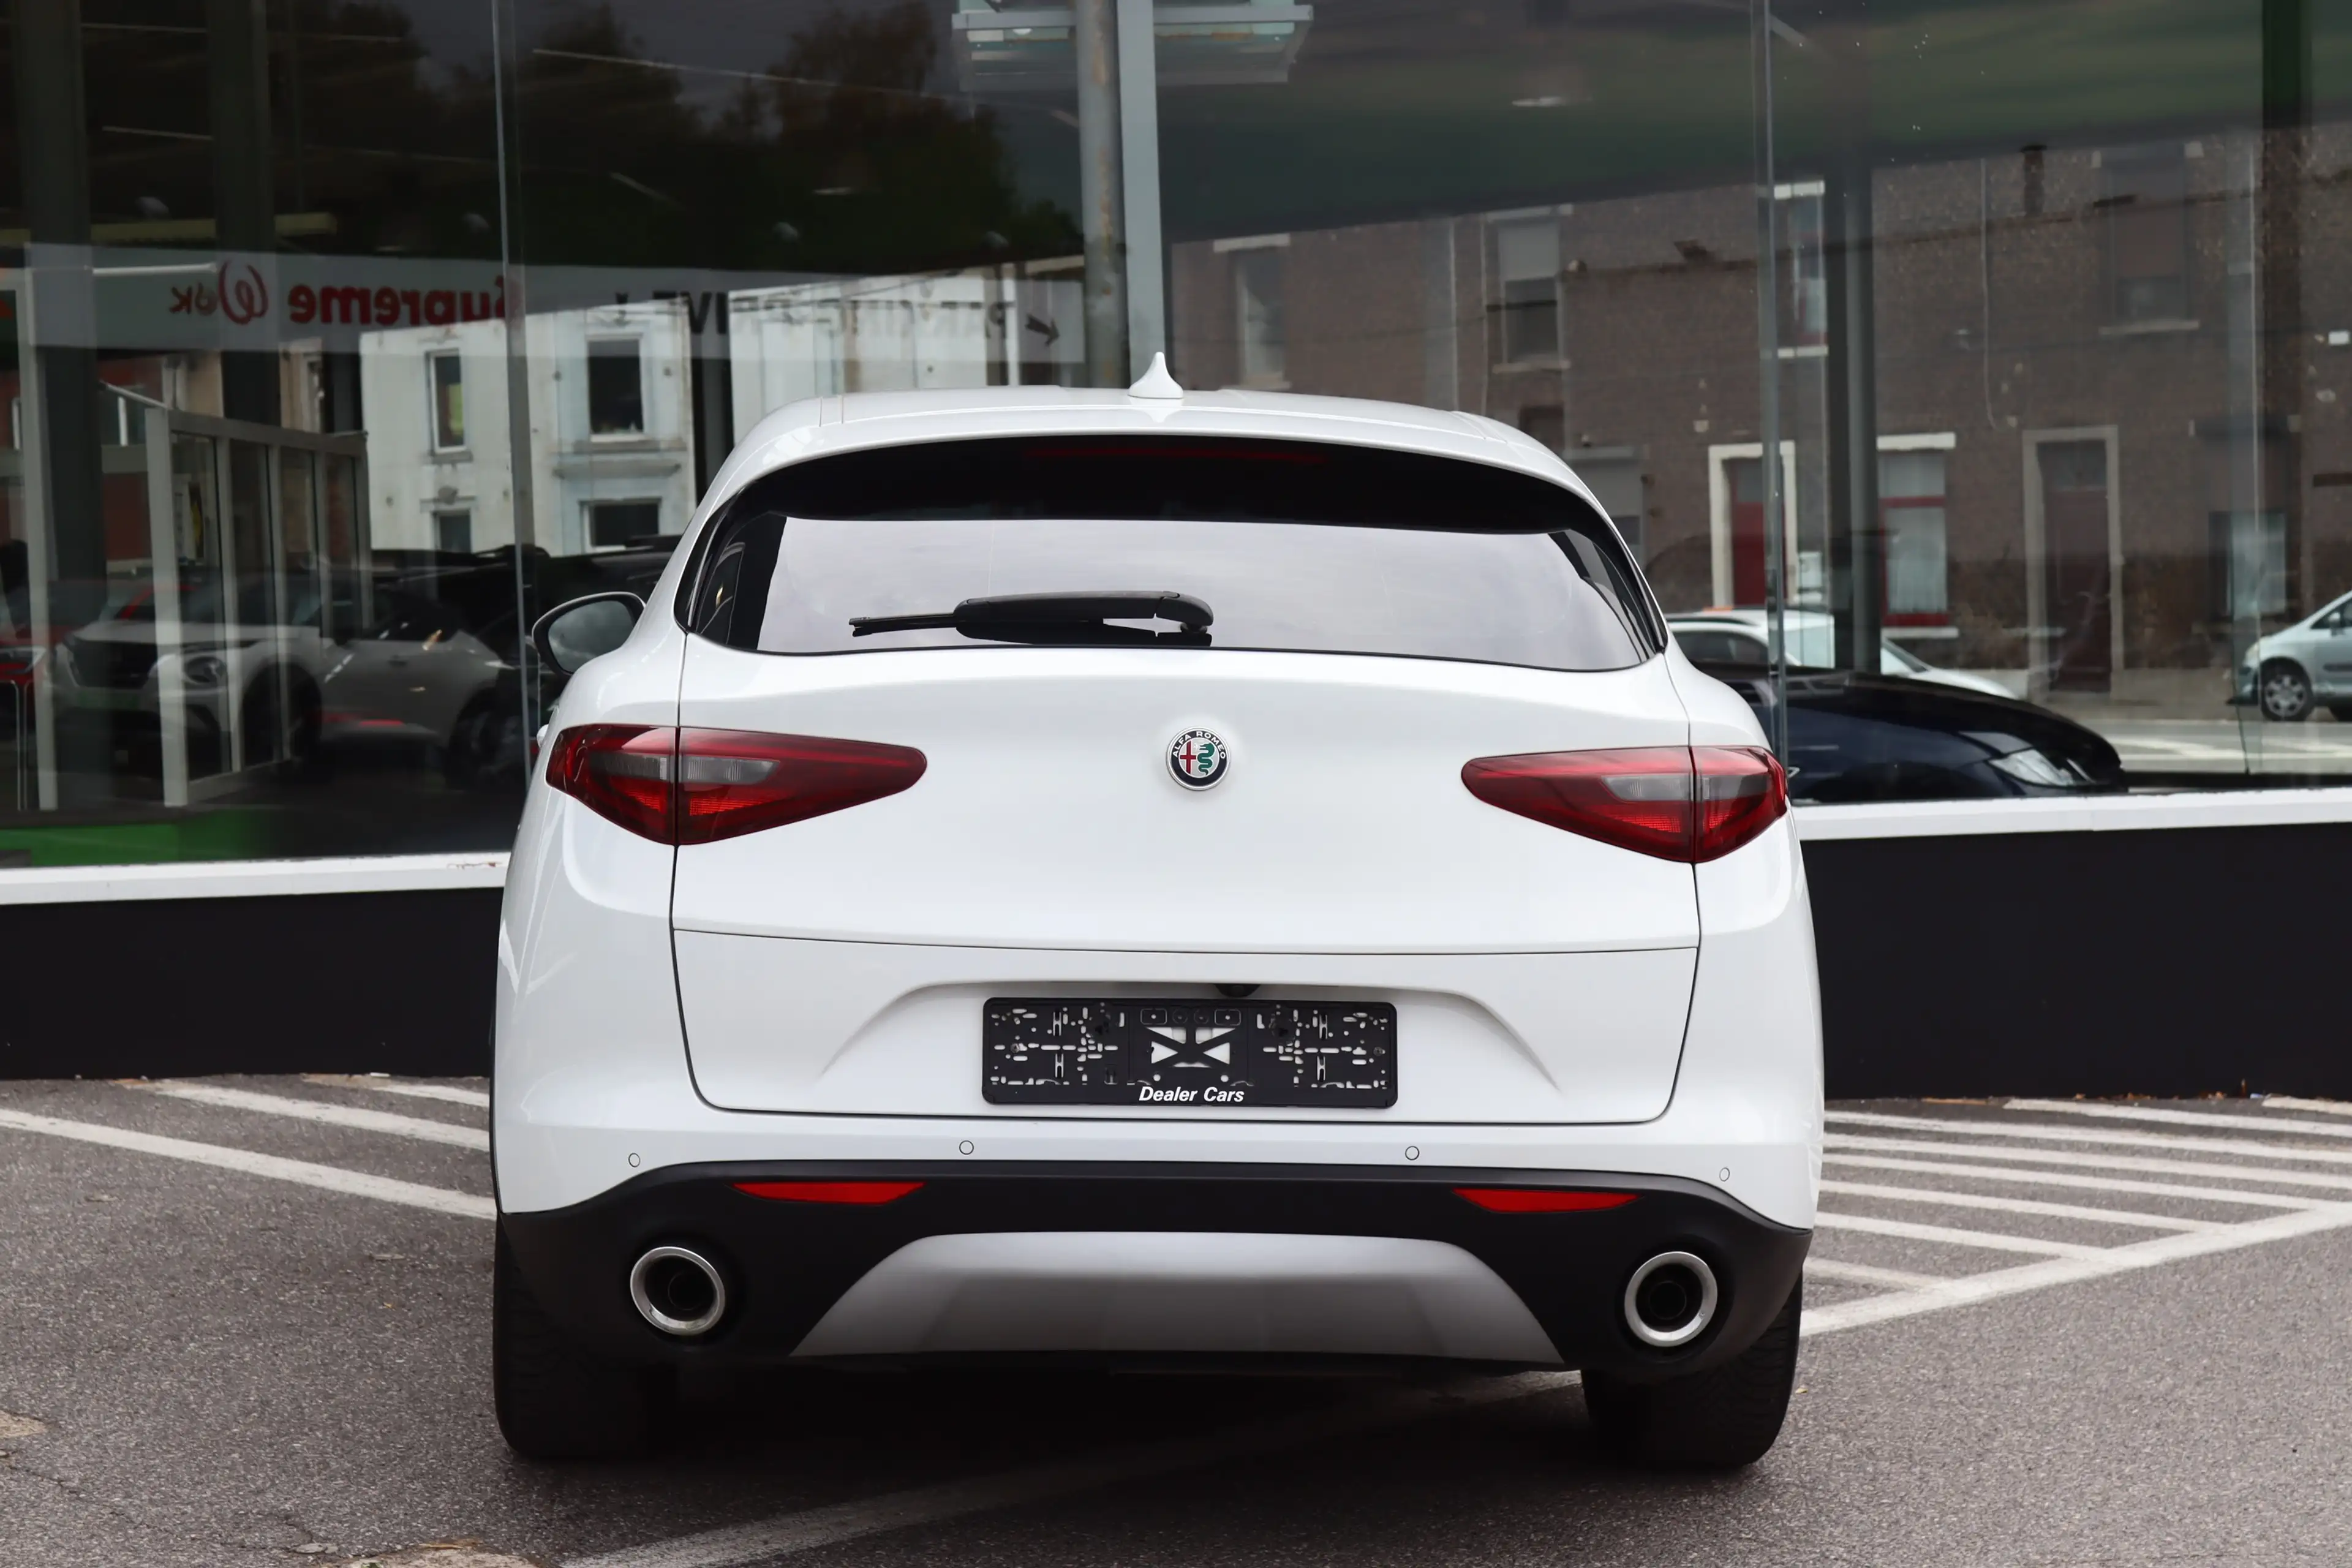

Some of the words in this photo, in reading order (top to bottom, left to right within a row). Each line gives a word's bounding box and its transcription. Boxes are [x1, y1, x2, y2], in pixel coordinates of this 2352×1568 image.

[1172, 734, 1191, 758] ALFA
[1196, 731, 1226, 759] ROMEO
[1139, 1086, 1198, 1101] Dealer
[1204, 1086, 1245, 1102] Cars
